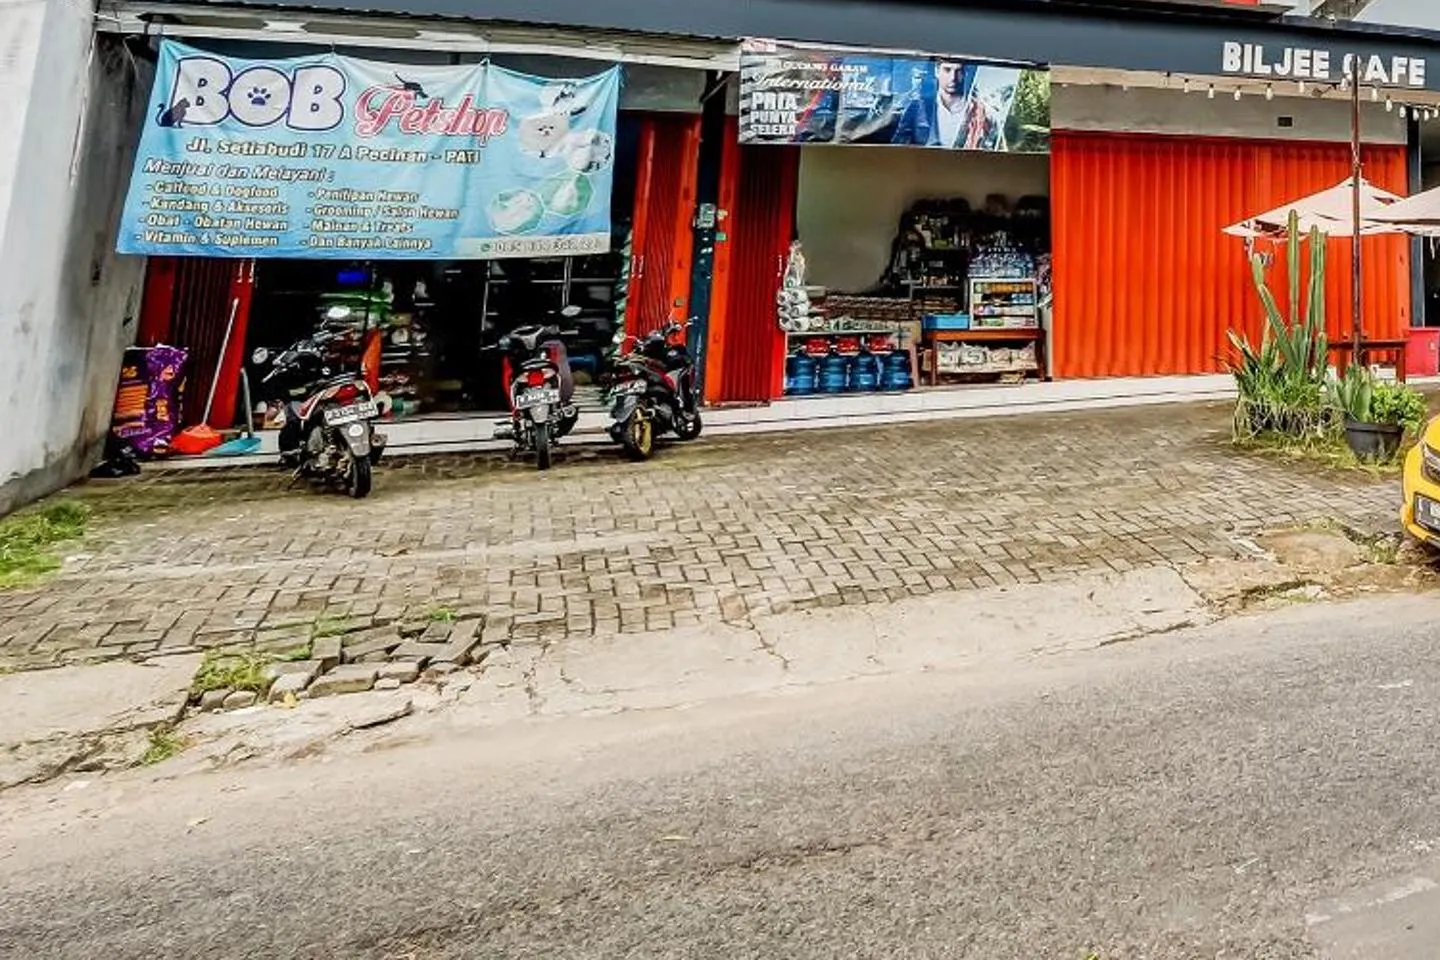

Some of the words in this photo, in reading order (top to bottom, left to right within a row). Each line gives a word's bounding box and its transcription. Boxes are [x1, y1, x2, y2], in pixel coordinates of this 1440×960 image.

[1222, 41, 1330, 79] BILJEE
[1343, 52, 1426, 87] CAFE
[752, 72, 875, 92] International
[171, 56, 347, 132] BOB
[752, 92, 798, 110] PRIA
[750, 111, 797, 124] PUNYA
[750, 124, 797, 136] SELERA
[218, 140, 308, 158] Setiabudi
[313, 144, 335, 159] 17
[339, 146, 351, 160] A
[357, 146, 428, 163] Pecinan
[445, 149, 480, 164] PATI
[143, 158, 215, 179] Menjual
[215, 163, 249, 179] dan
[225, 184, 279, 199] Dogfood
[151, 197, 209, 214] Kandang
[227, 200, 290, 216] Aksesoris
[244, 217, 289, 231] Hewan
[143, 230, 197, 244] Vitamin
[214, 233, 279, 248] Suplemen
[309, 234, 334, 248] Dan
[336, 236, 382, 250] Banyak
